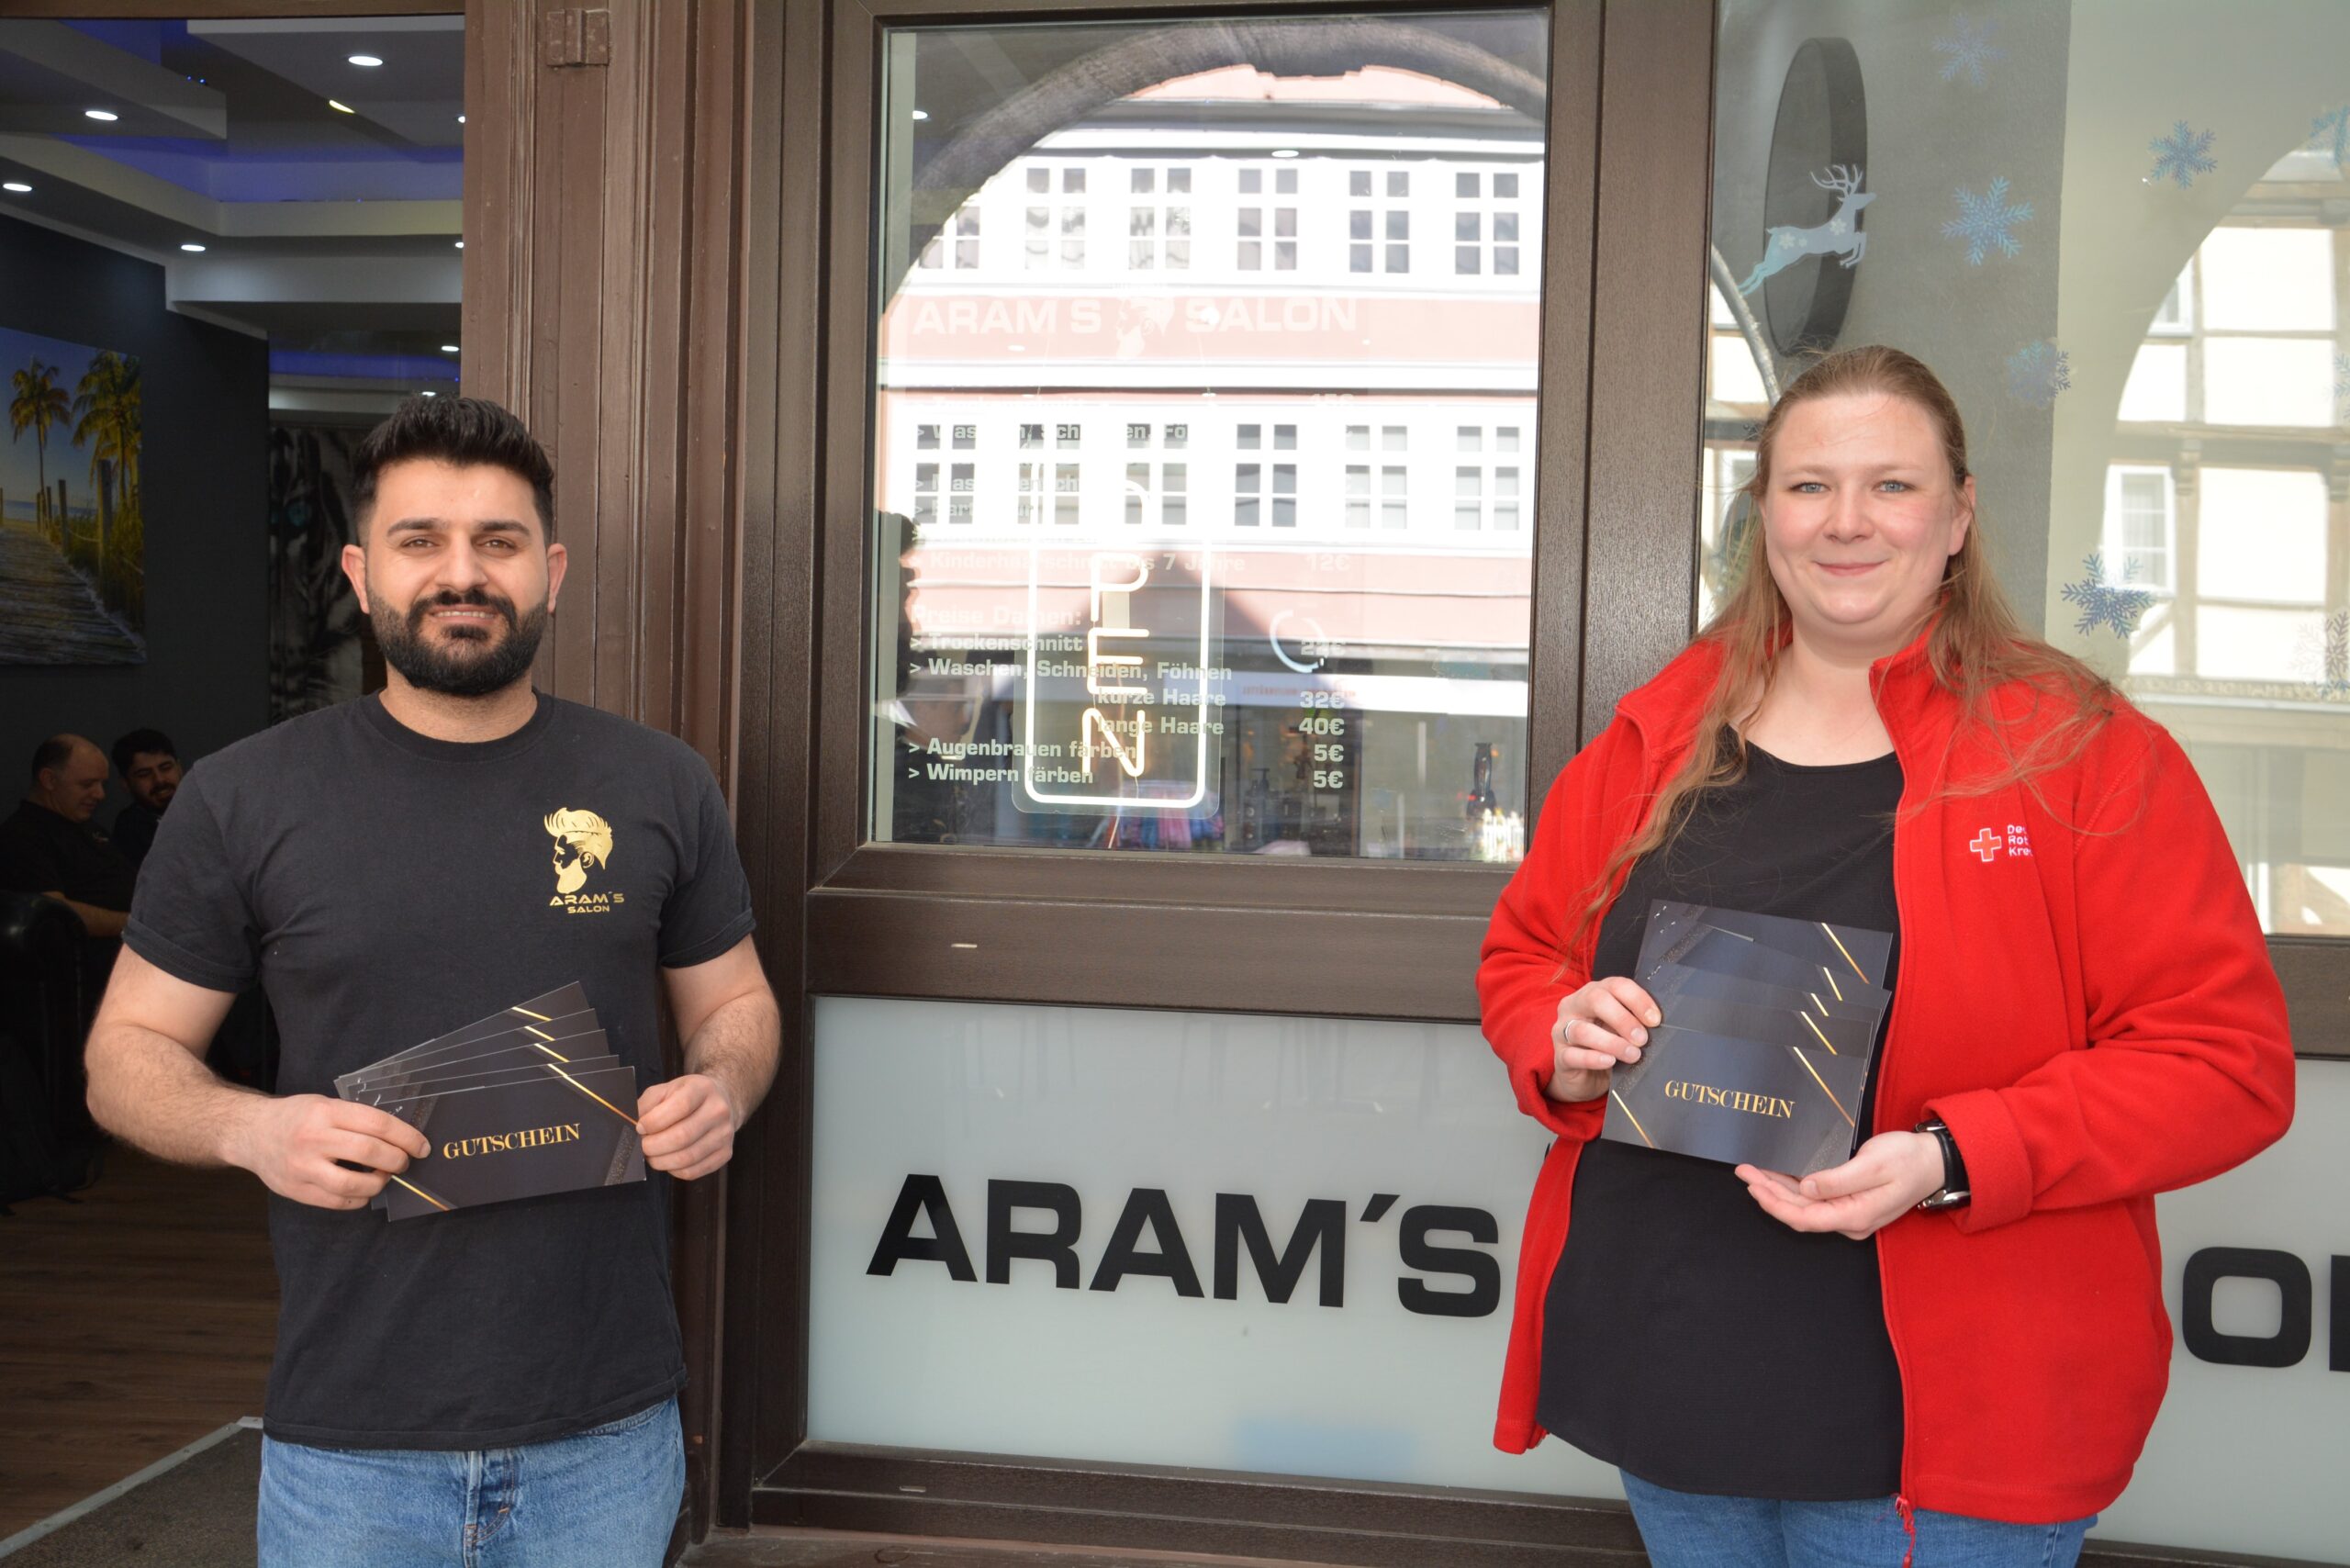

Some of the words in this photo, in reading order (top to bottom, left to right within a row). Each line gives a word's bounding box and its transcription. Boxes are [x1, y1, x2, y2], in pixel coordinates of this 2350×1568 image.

[1185, 297, 1357, 332] SALON
[1163, 553, 1176, 570] 7
[1304, 553, 1351, 572] 12€
[912, 604, 984, 624] Preise
[929, 633, 1083, 651] Trockenschnitt
[928, 658, 1028, 680] Waschen,
[1036, 660, 1147, 681] Schneiden,
[1157, 662, 1232, 680] Föhnen
[1098, 688, 1155, 704] kurze
[1162, 689, 1226, 706] Haare
[1300, 691, 1345, 709] 32€
[1098, 716, 1153, 737] lange
[1160, 717, 1225, 734] Haare
[1299, 718, 1345, 735] 40€
[927, 737, 1061, 760] Augenbrauen
[1069, 741, 1136, 758] färben
[1314, 745, 1344, 762] 5€
[926, 763, 1019, 785] Wimpern
[1027, 767, 1093, 783] färben
[1313, 770, 1344, 789] 5€
[567, 905, 610, 913] SALON
[1664, 1080, 1796, 1118] GUTSCHEIN
[443, 1123, 581, 1159] GUTSCHEIN
